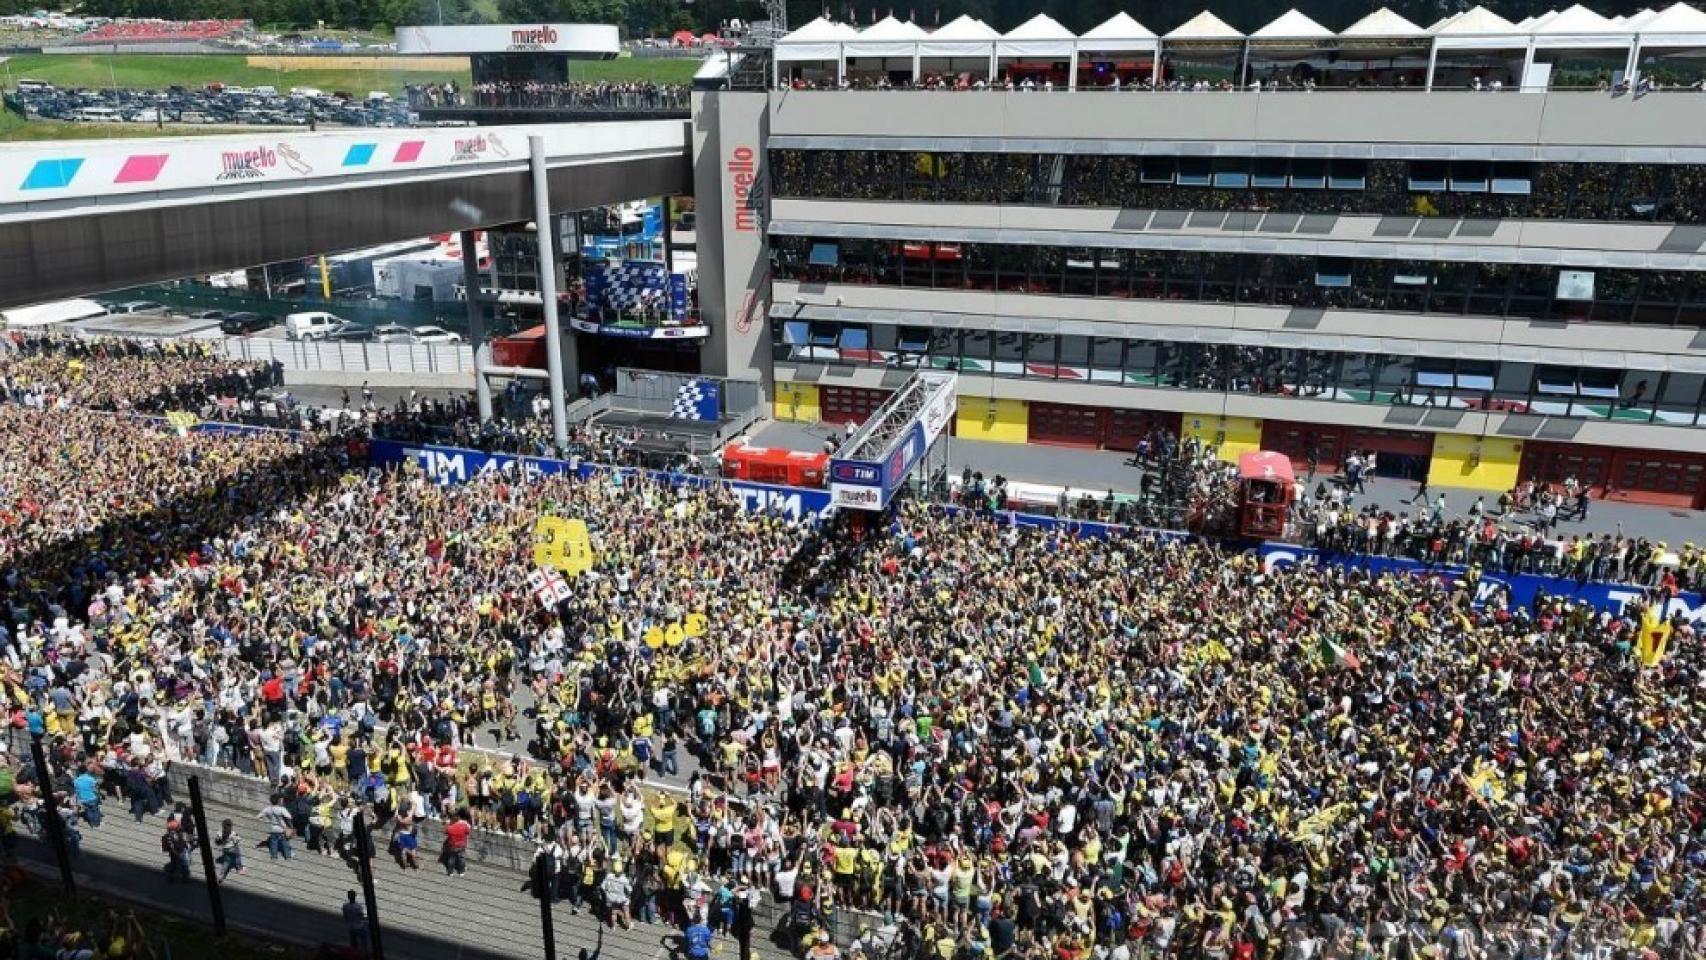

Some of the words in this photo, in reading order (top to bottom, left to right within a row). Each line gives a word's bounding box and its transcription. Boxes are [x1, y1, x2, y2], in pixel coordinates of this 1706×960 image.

[512, 24, 558, 44] mugello
[222, 144, 277, 170] mugello
[728, 147, 754, 231] mugello
[854, 468, 875, 479] TIM
